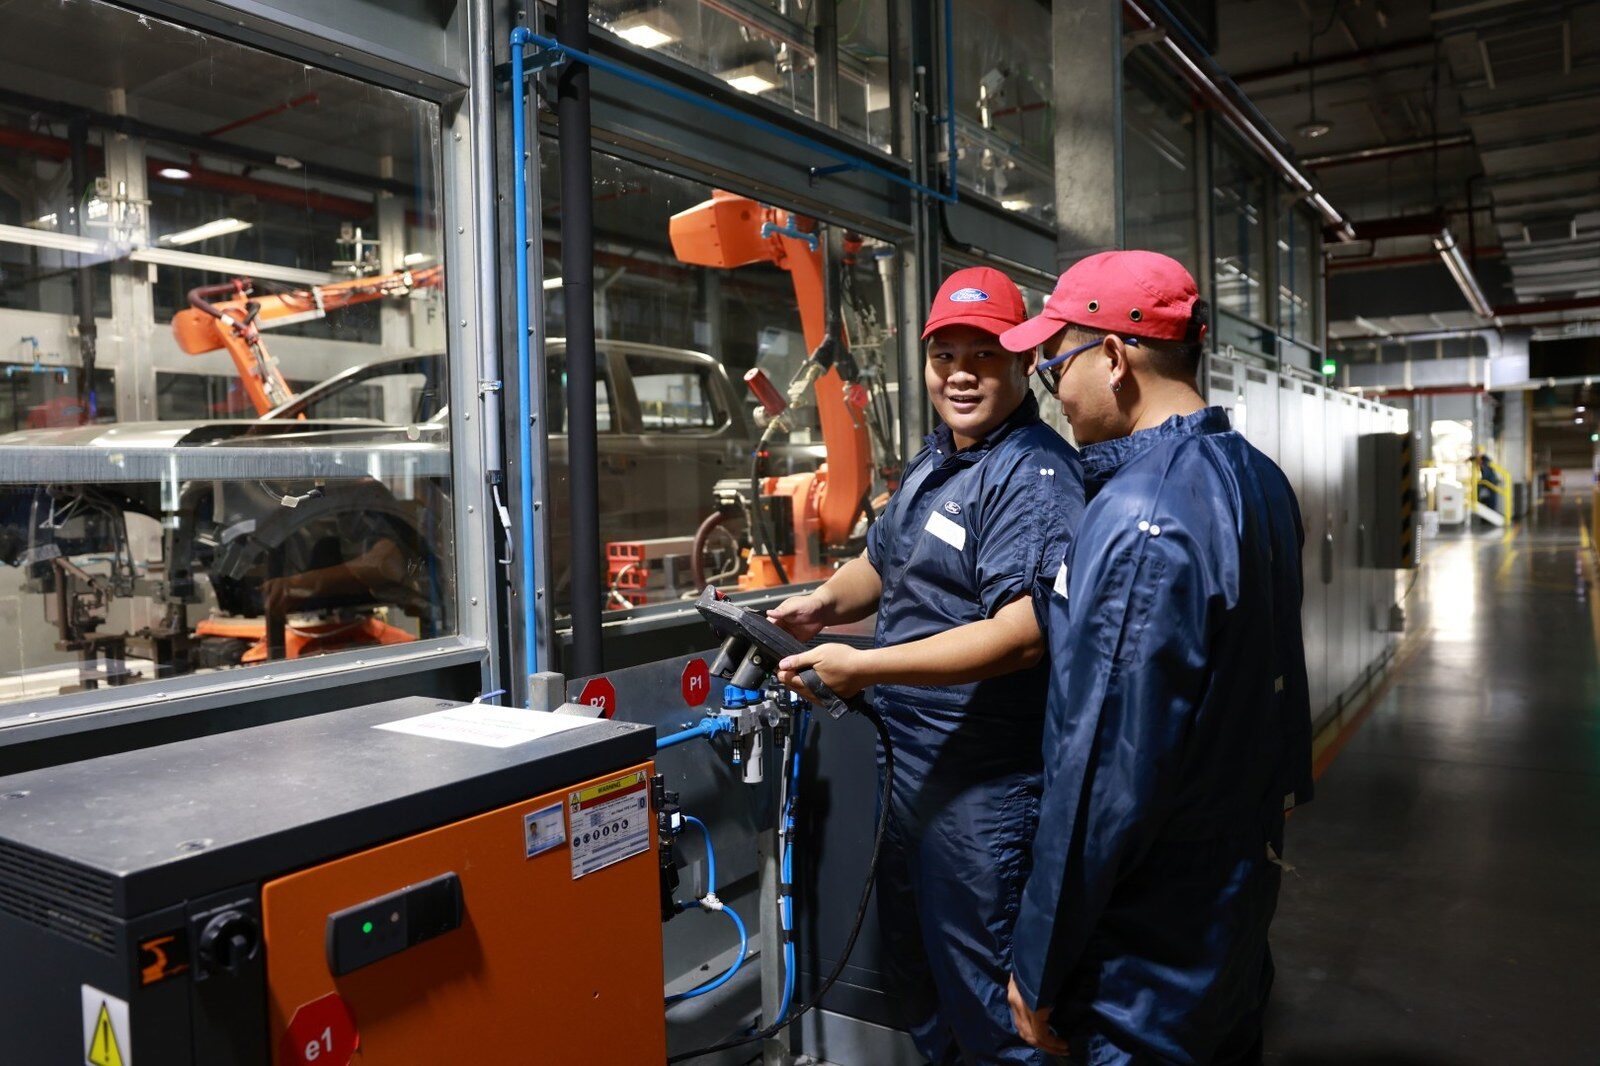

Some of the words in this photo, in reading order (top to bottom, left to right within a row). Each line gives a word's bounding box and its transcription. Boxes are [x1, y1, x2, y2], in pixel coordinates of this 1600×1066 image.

[955, 290, 983, 301] Ford
[690, 675, 702, 691] P1
[597, 781, 621, 793] WARNING
[304, 1026, 332, 1061] e1
